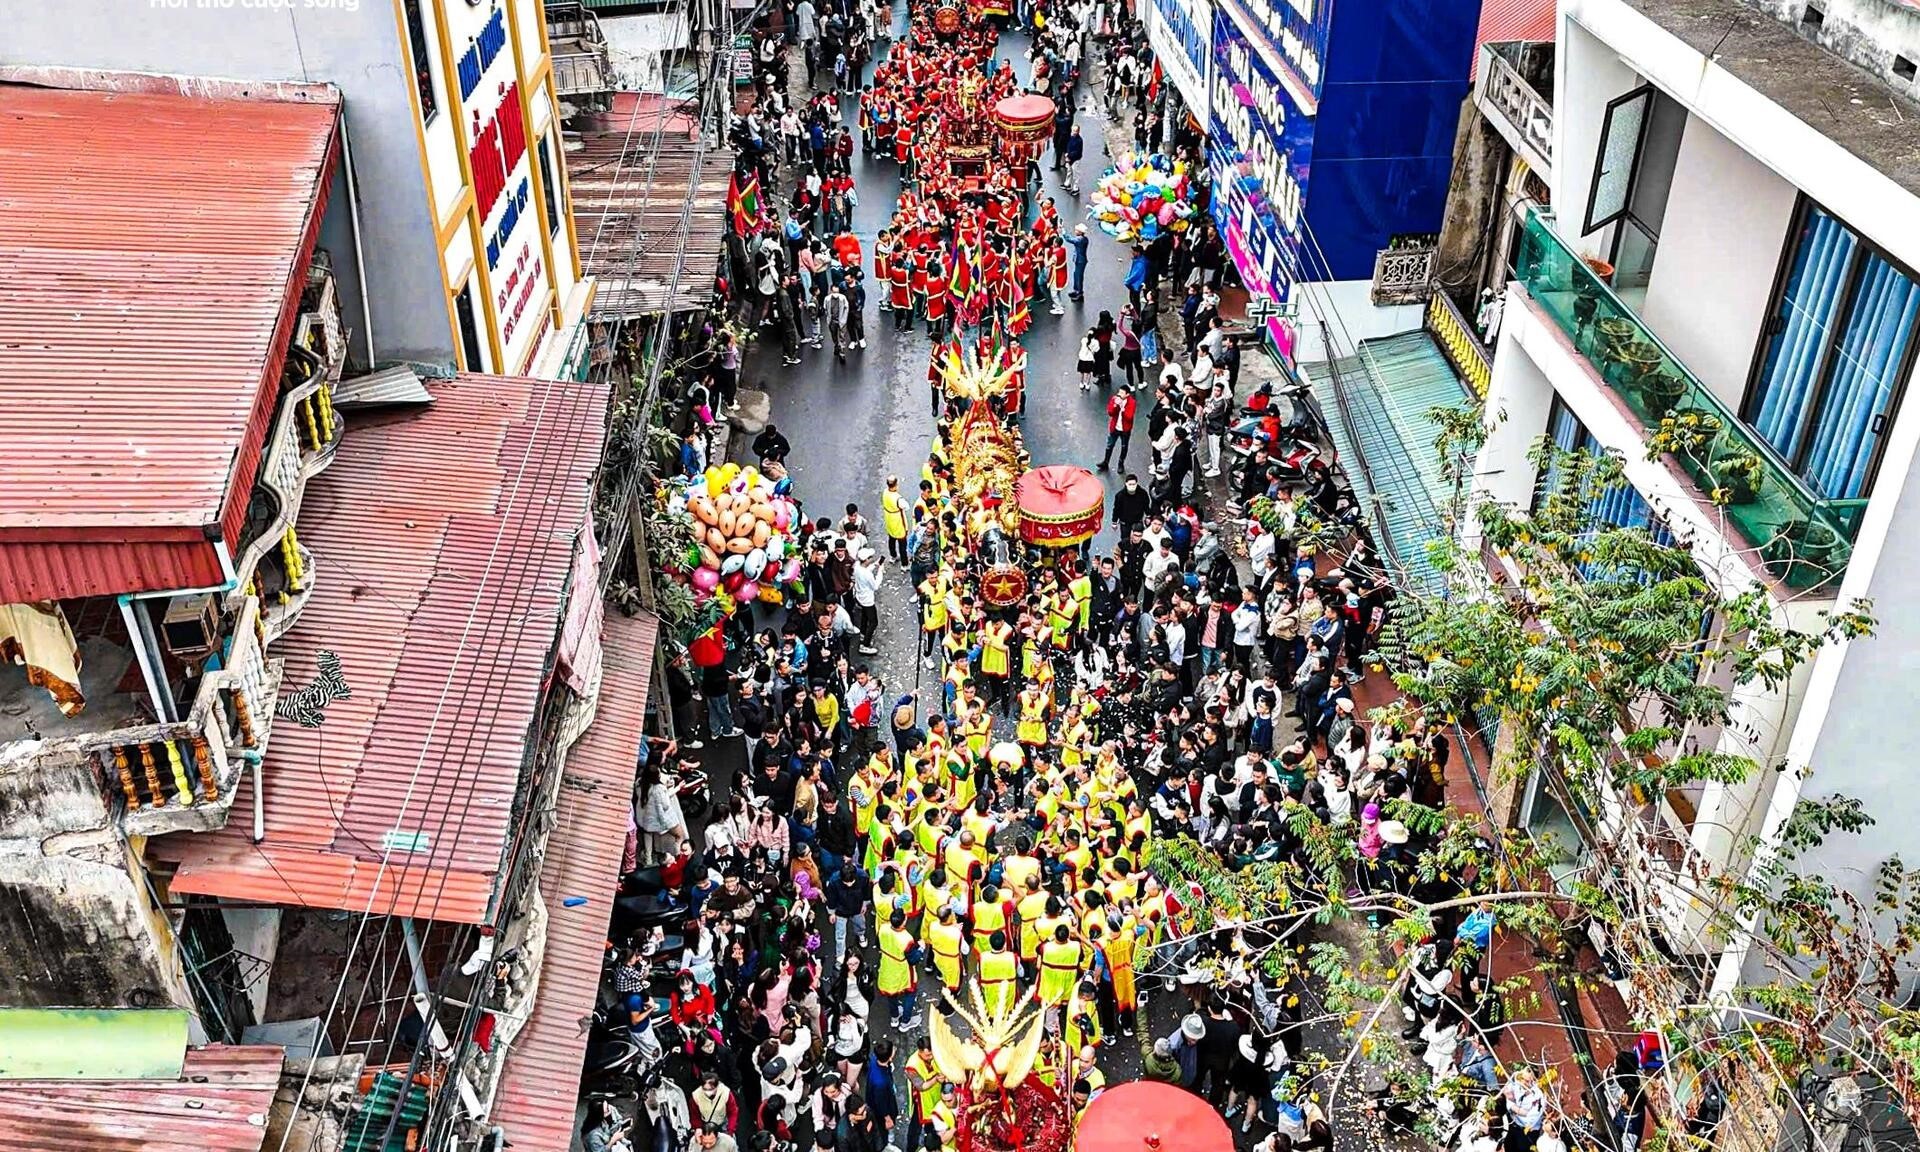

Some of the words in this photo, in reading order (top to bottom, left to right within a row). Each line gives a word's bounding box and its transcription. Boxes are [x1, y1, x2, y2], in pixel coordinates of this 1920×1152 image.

[1212, 62, 1250, 155] LONG
[1252, 129, 1301, 234] CHÂU
[1230, 40, 1249, 86] NHÀ
[1252, 66, 1286, 136] THUỐC
